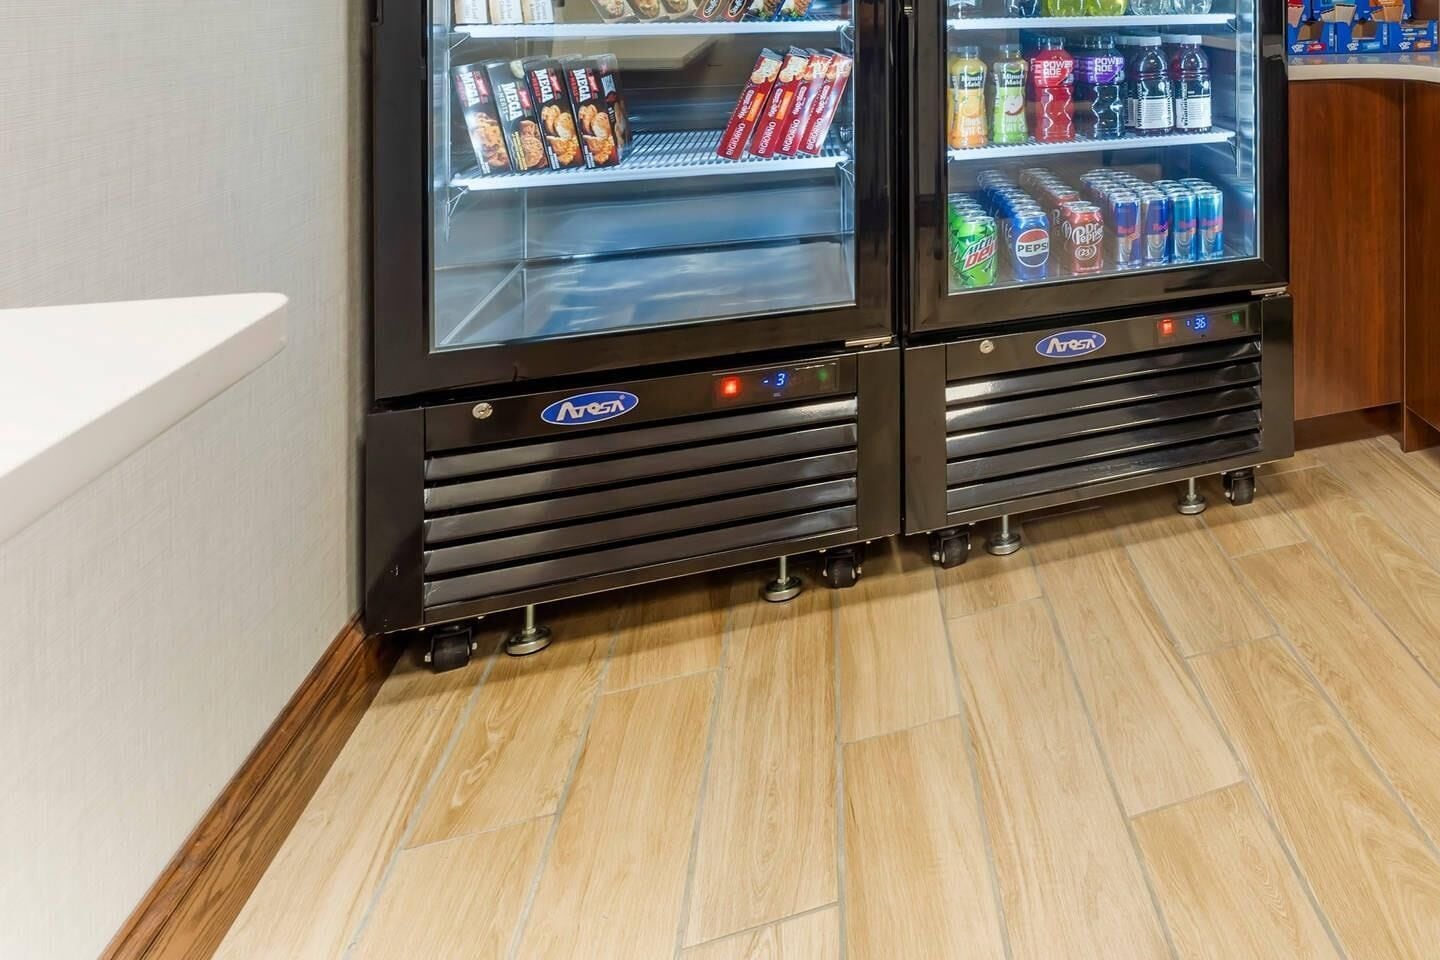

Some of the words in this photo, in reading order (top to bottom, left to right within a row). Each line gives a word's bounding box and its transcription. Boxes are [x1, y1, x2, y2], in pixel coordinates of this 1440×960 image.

[501, 82, 523, 121] MEGA
[534, 68, 554, 103] MEGA
[573, 68, 592, 103] MEGA
